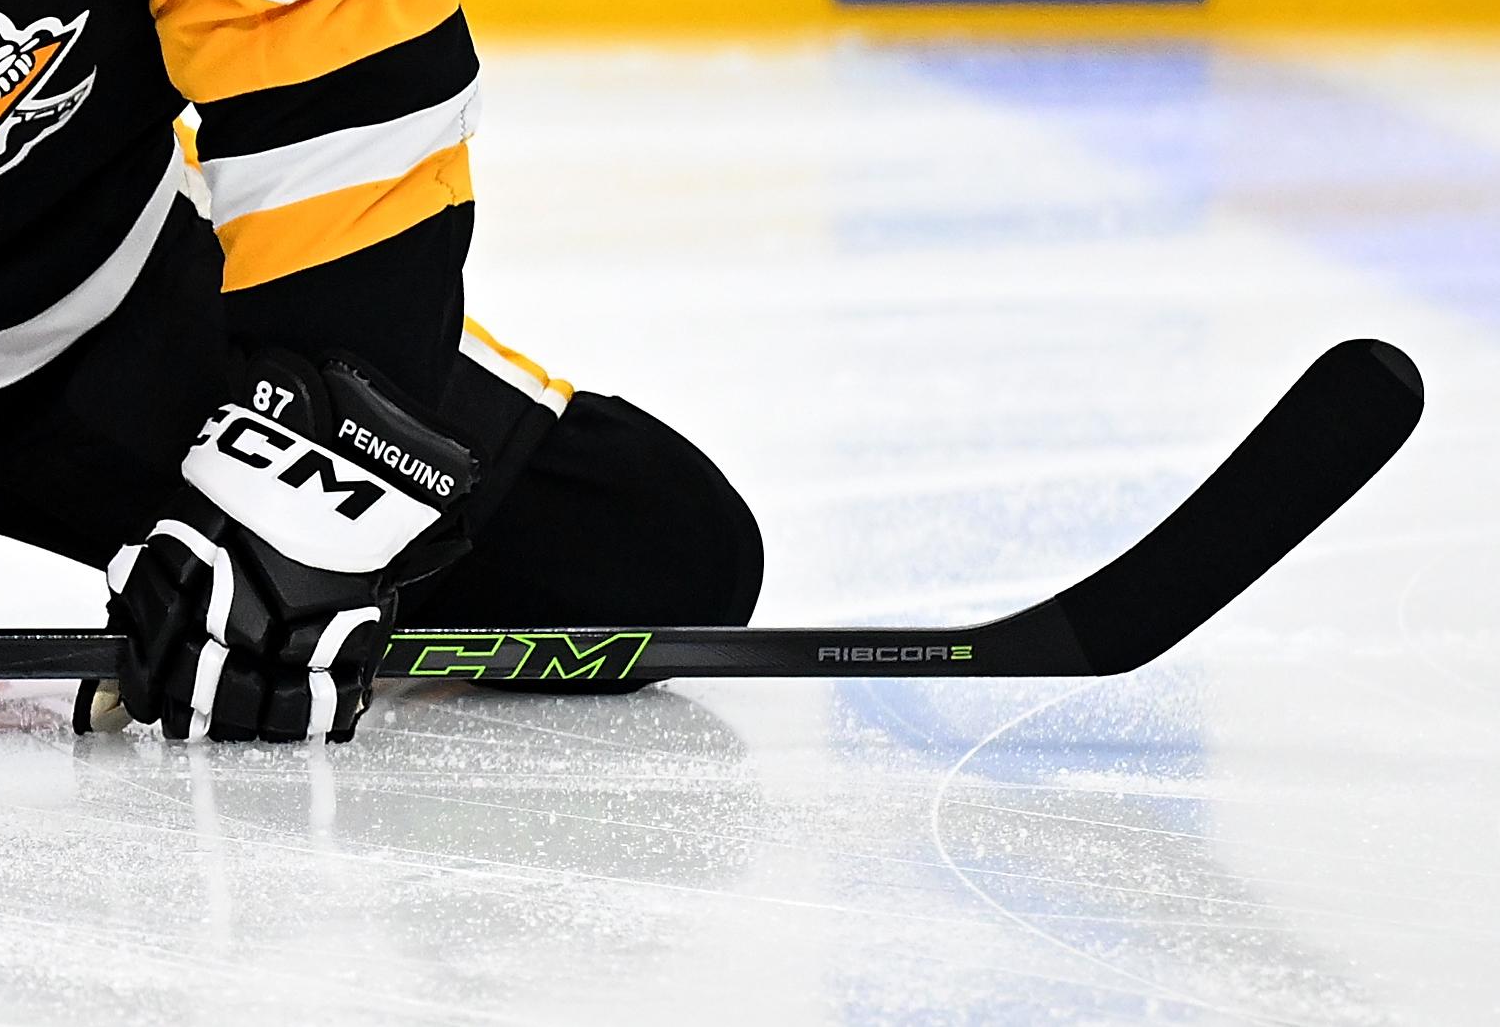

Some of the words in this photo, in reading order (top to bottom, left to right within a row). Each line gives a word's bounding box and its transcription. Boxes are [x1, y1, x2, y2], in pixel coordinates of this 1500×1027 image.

[253, 380, 295, 420] 87
[197, 410, 387, 521] CM
[338, 418, 455, 497] PENGUINS
[376, 632, 653, 679] CM
[818, 645, 973, 662] RIBCORE
